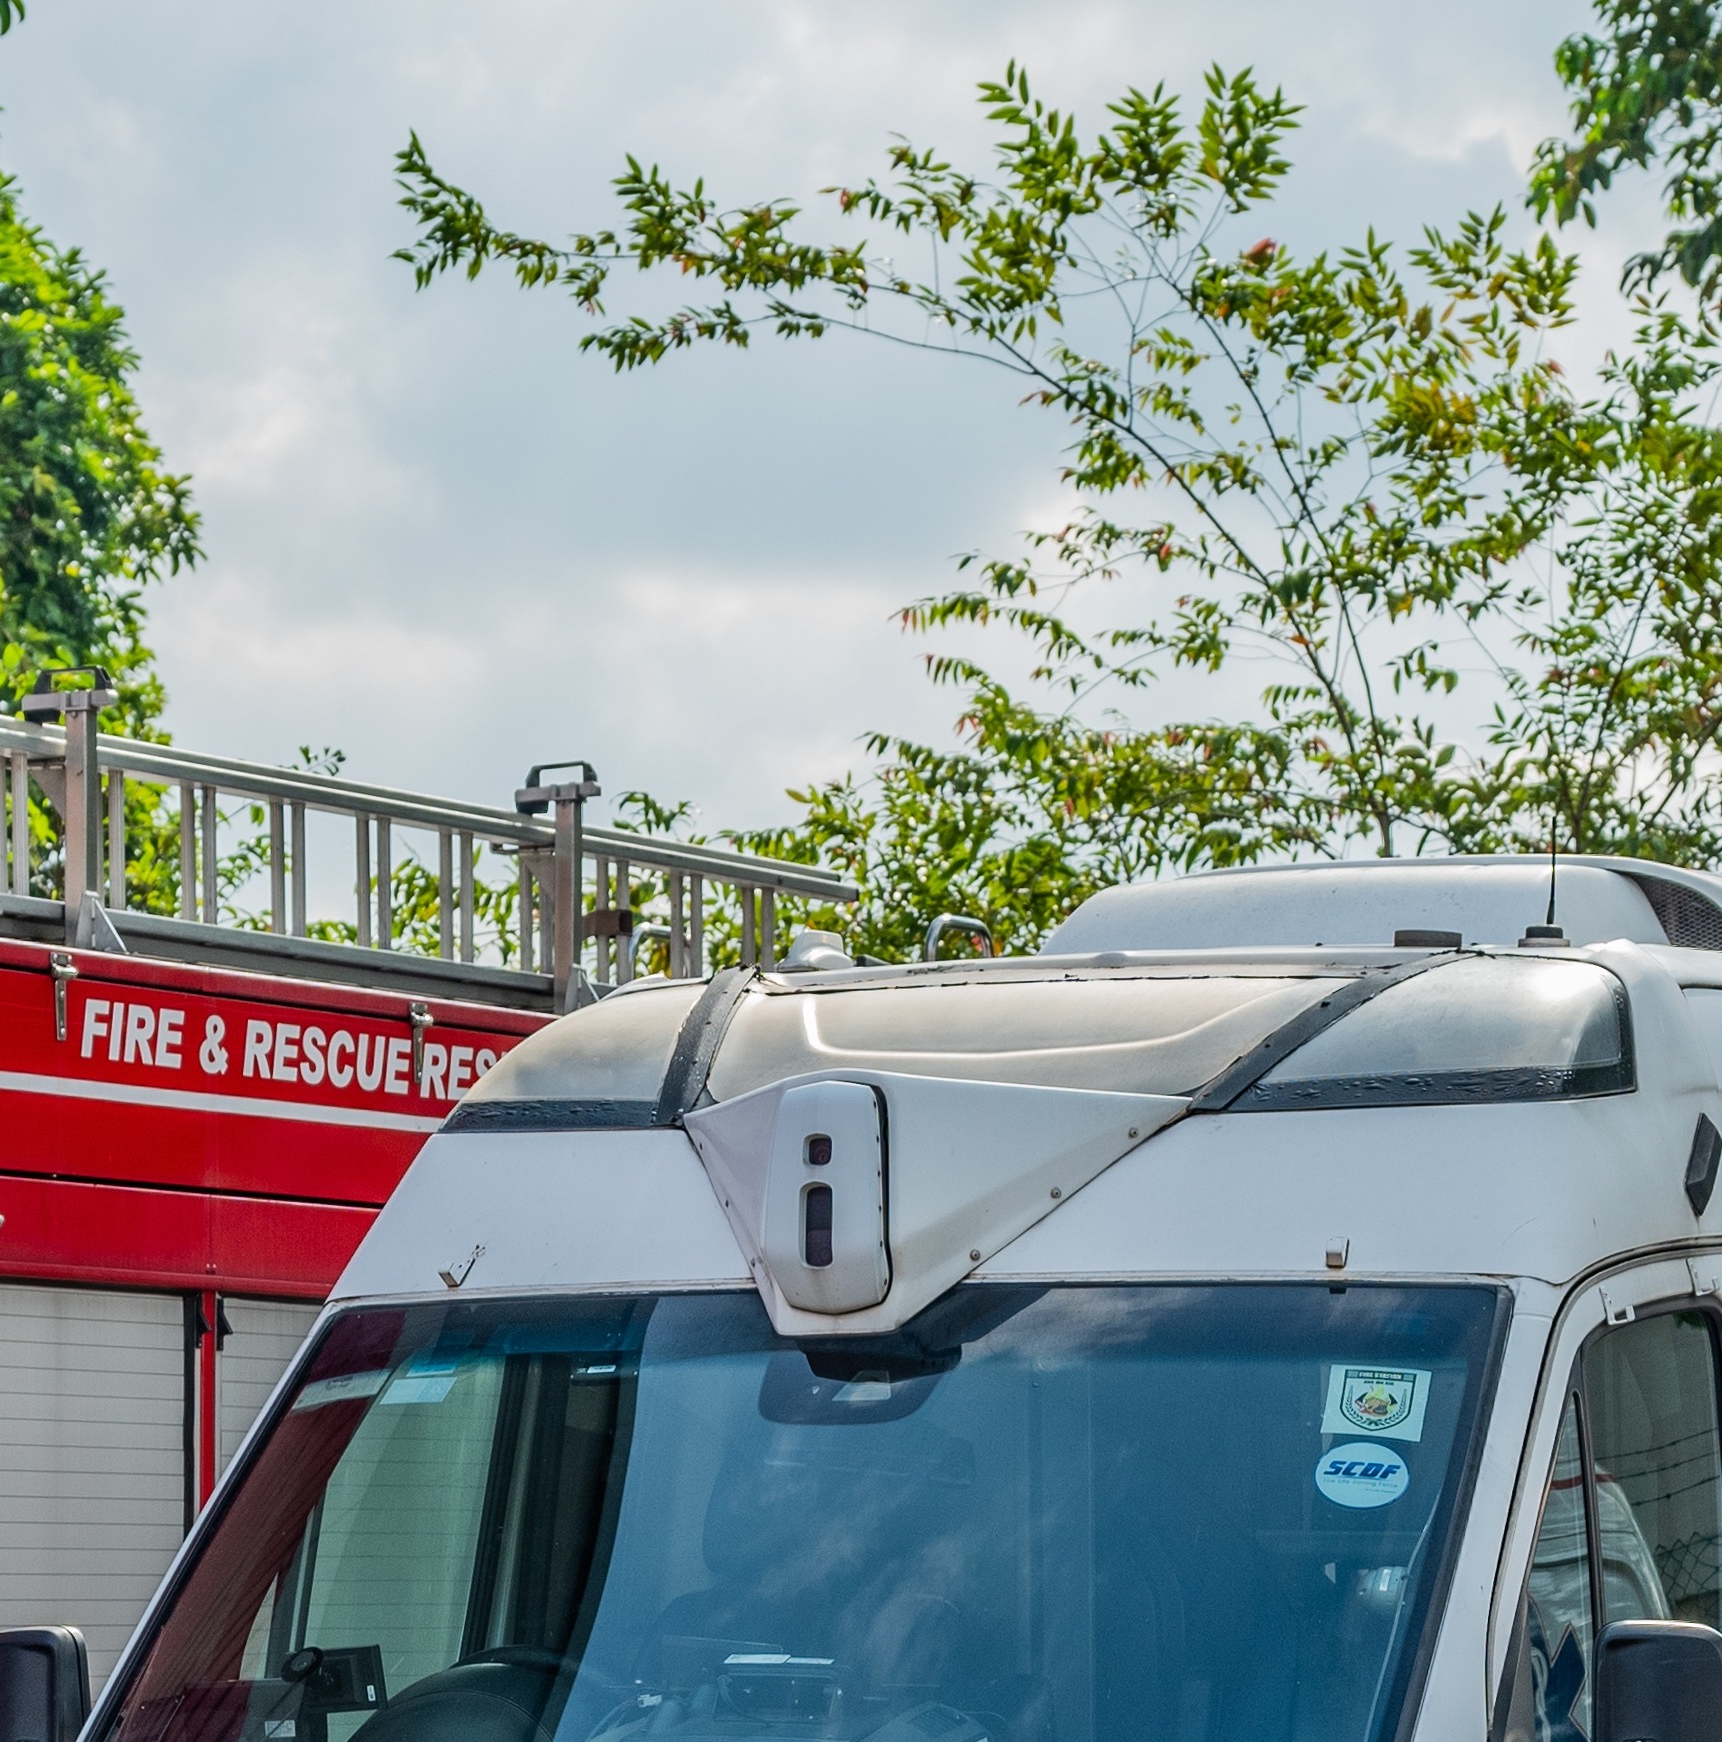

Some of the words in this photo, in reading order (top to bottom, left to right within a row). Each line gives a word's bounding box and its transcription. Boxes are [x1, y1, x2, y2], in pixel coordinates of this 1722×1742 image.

[80, 997, 186, 1070] FIRE
[198, 1014, 229, 1076] &
[242, 1019, 410, 1096] RESCUE
[420, 1043, 507, 1101] RES
[1323, 1460, 1401, 1480] SCDF
